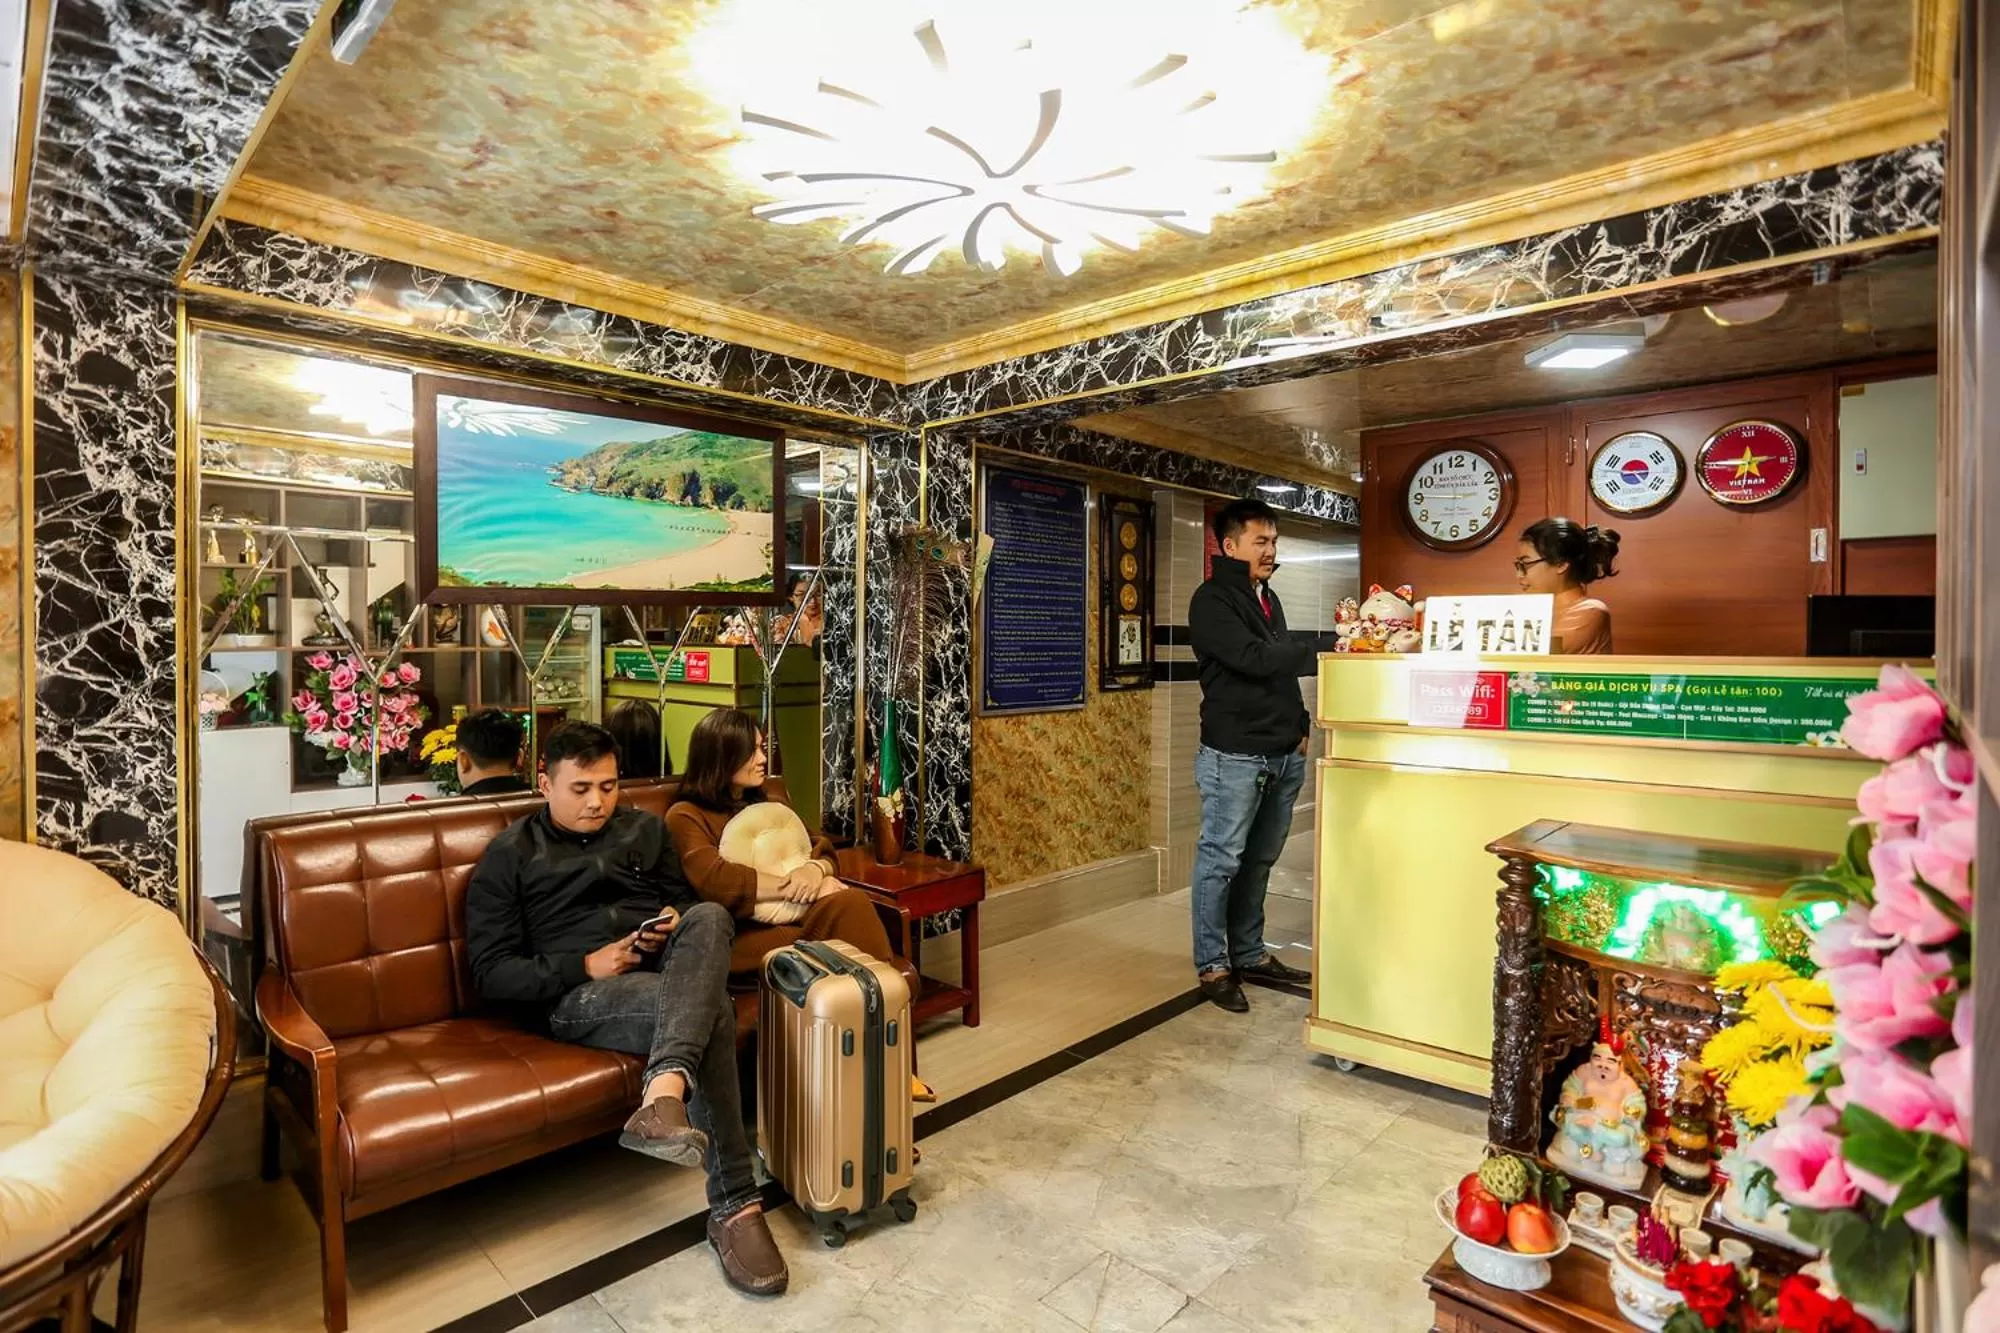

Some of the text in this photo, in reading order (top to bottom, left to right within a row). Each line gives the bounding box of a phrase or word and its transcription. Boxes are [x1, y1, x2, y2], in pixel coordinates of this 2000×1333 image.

[1742, 430, 1755, 438] XII
[1433, 462, 1444, 474] 11
[1448, 455, 1464, 468] 12
[1471, 458, 1477, 472] 1
[1418, 476, 1434, 488] 10
[1484, 471, 1495, 484] 2
[1728, 478, 1766, 487] VIETNAM
[1414, 492, 1424, 505] 9
[1488, 488, 1499, 501] 3
[1420, 508, 1429, 522] 8
[1482, 506, 1492, 519] 4
[1432, 521, 1441, 534] 7
[1449, 525, 1460, 538] 6
[1468, 520, 1479, 532] 5
[1430, 602, 1542, 652] LỄ TÂN
[1420, 684, 1496, 698] Pass Wifi:
[1552, 678, 1582, 690] BẢNG
[1608, 683, 1638, 694] DỊCH
[1641, 683, 1657, 694] VỤ
[1660, 684, 1683, 693] SPA
[1686, 684, 1710, 696] (Gọi
[1730, 686, 1753, 696] tân:
[1756, 687, 1782, 697] 100)
